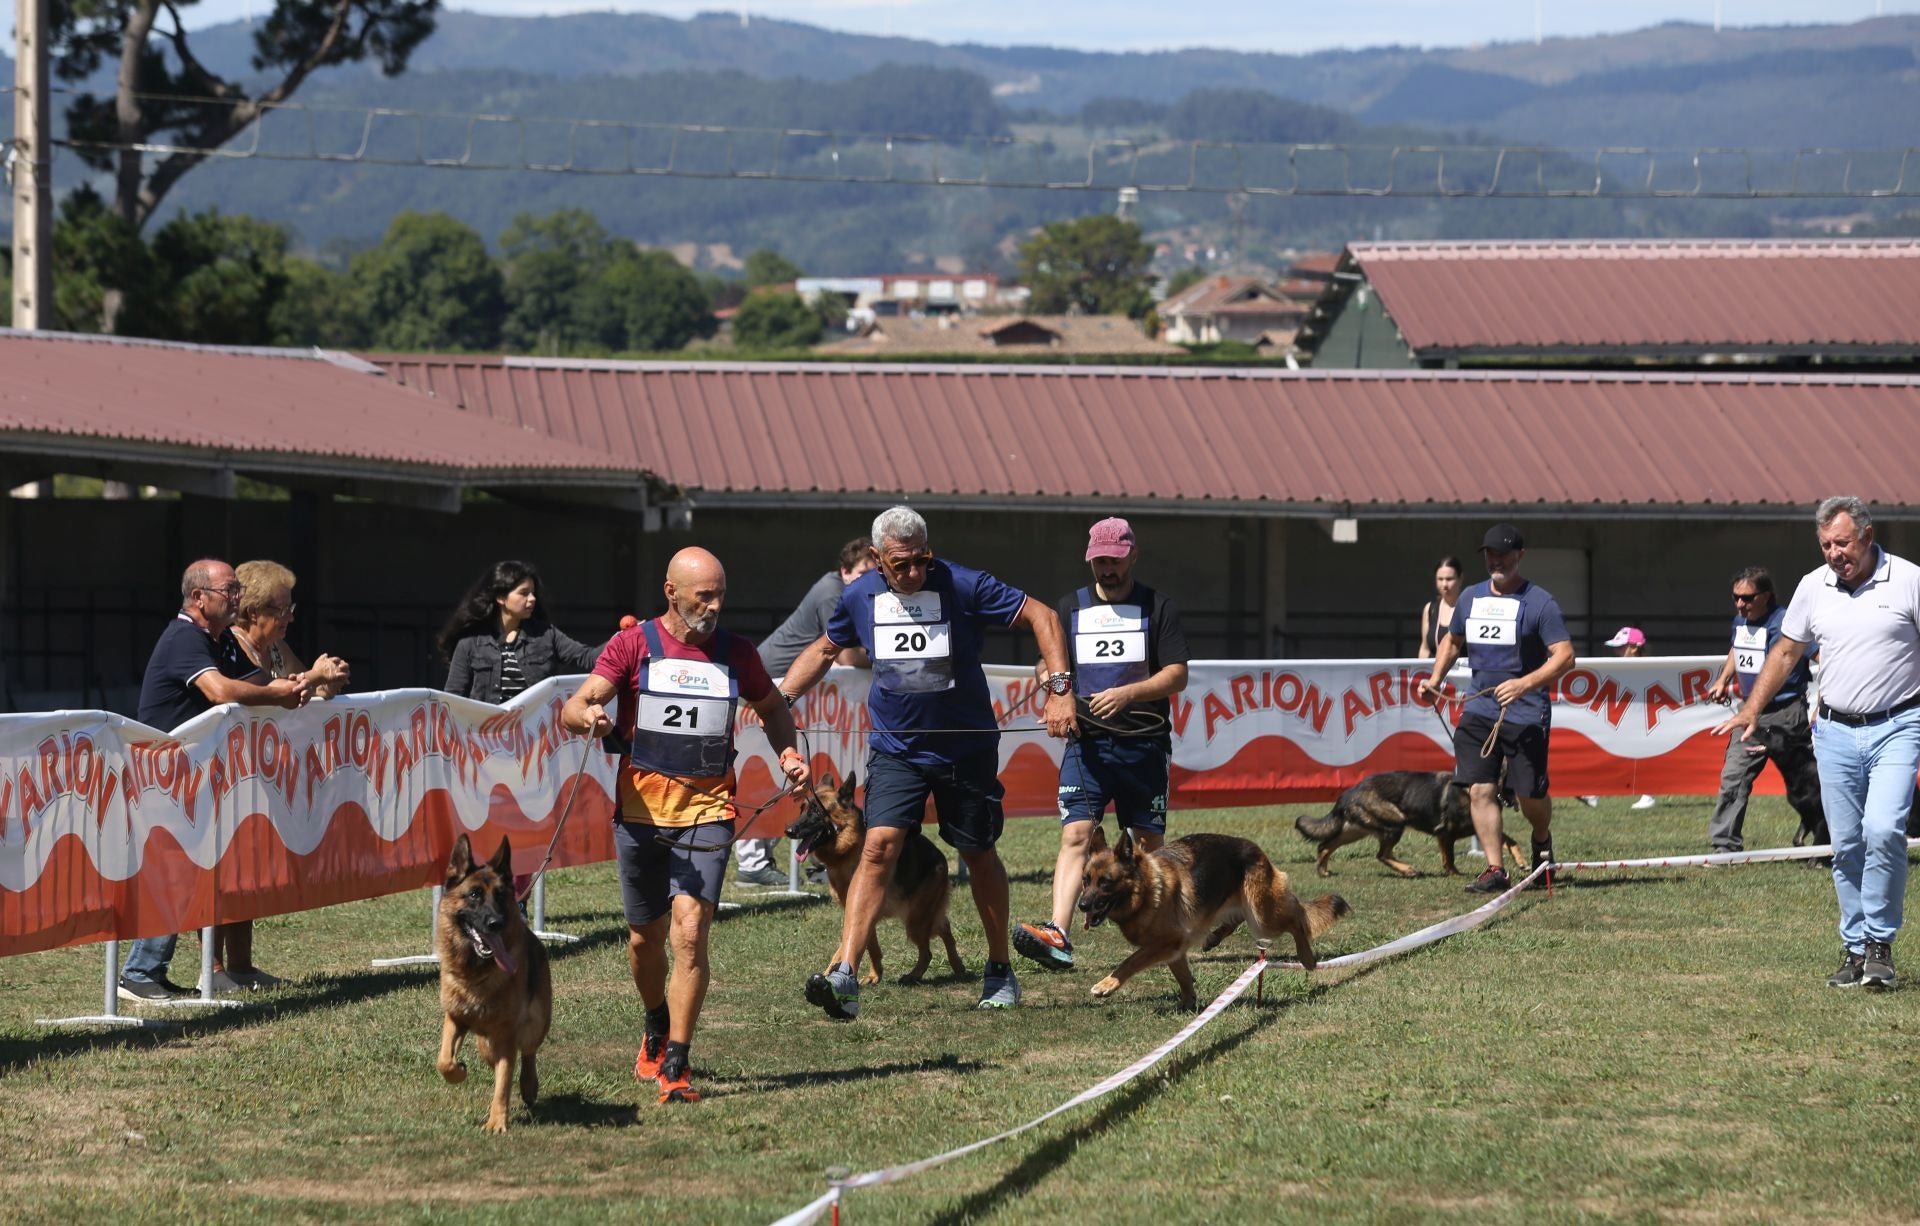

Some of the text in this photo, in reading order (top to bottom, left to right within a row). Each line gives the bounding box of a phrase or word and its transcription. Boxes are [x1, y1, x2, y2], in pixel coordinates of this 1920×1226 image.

[894, 632, 927, 652] 20
[1479, 625, 1501, 639] 22
[1095, 640, 1125, 657] 23
[1739, 654, 1753, 668] 24
[993, 676, 1048, 727] RIO
[1202, 668, 1335, 745] ARION
[1553, 667, 1641, 731] ION
[663, 704, 699, 728] 21
[18, 729, 119, 848] ARION
[121, 739, 203, 838] ARION
[208, 718, 300, 824] ARION
[306, 709, 390, 818] ARION
